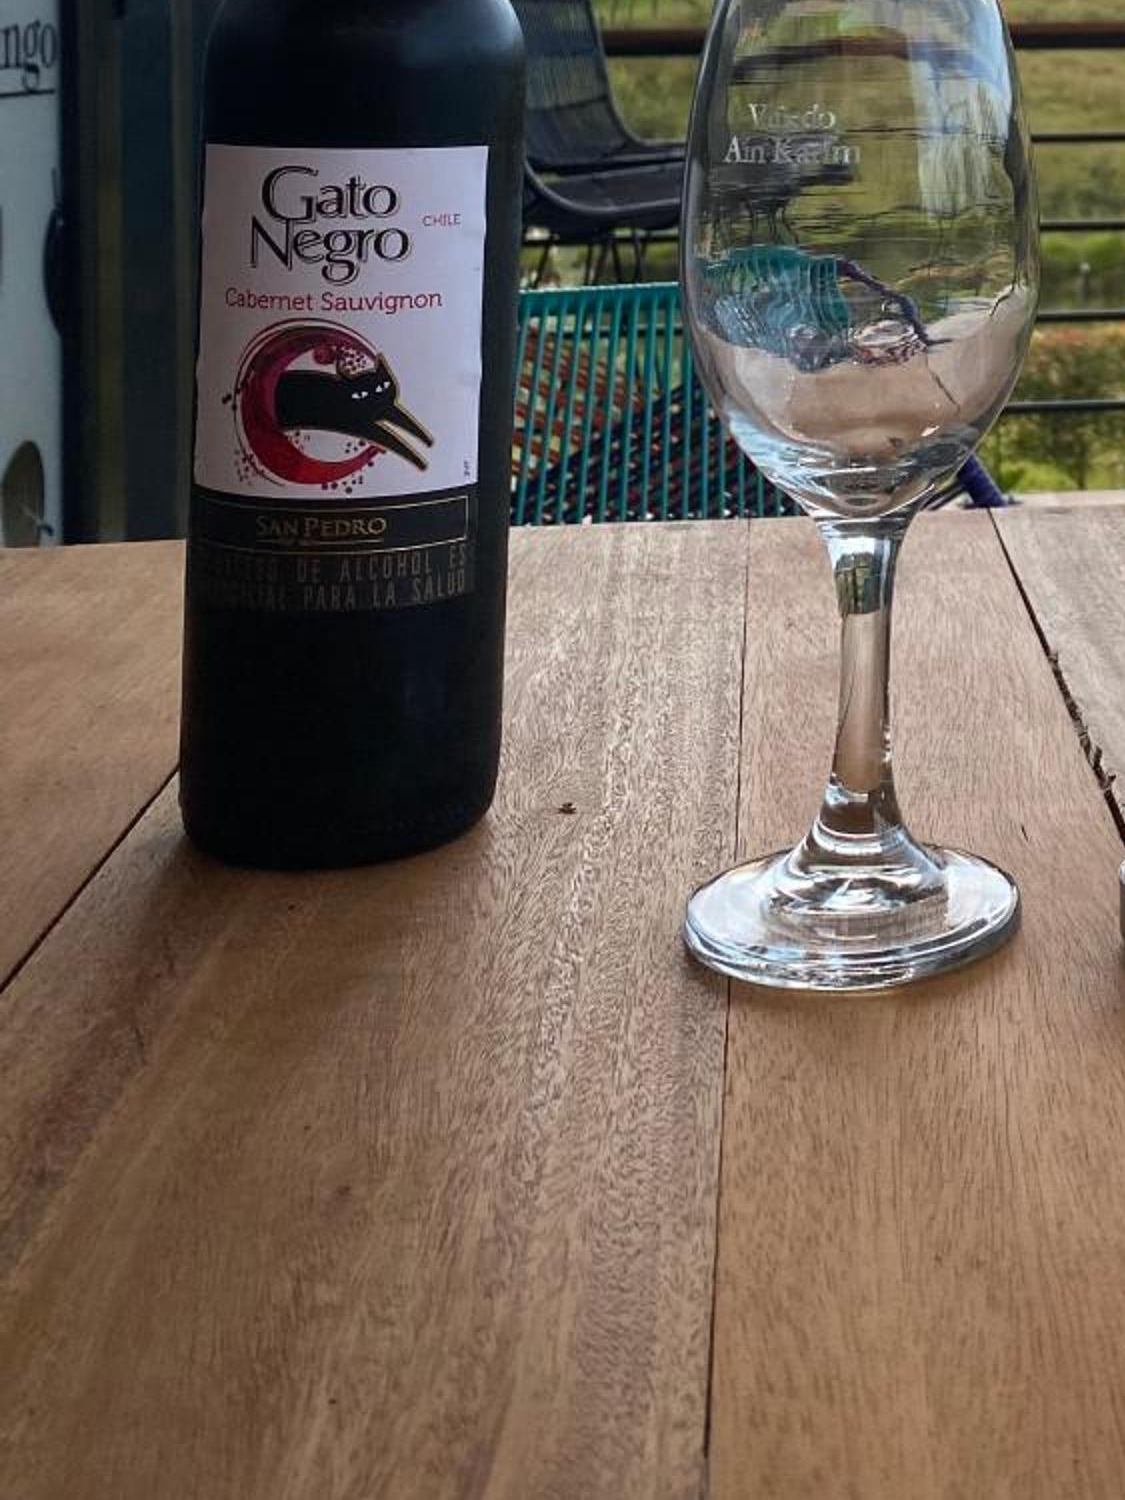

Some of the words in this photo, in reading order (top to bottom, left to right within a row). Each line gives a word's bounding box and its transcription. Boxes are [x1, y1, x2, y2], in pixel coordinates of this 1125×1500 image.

[723, 135, 767, 165] Ain
[262, 165, 399, 224] Gato
[422, 212, 462, 228] CHILE
[251, 215, 414, 286] Negro
[225, 287, 314, 312] Cabernet
[320, 290, 443, 315] Sauvignon
[303, 516, 387, 538] PEDRO
